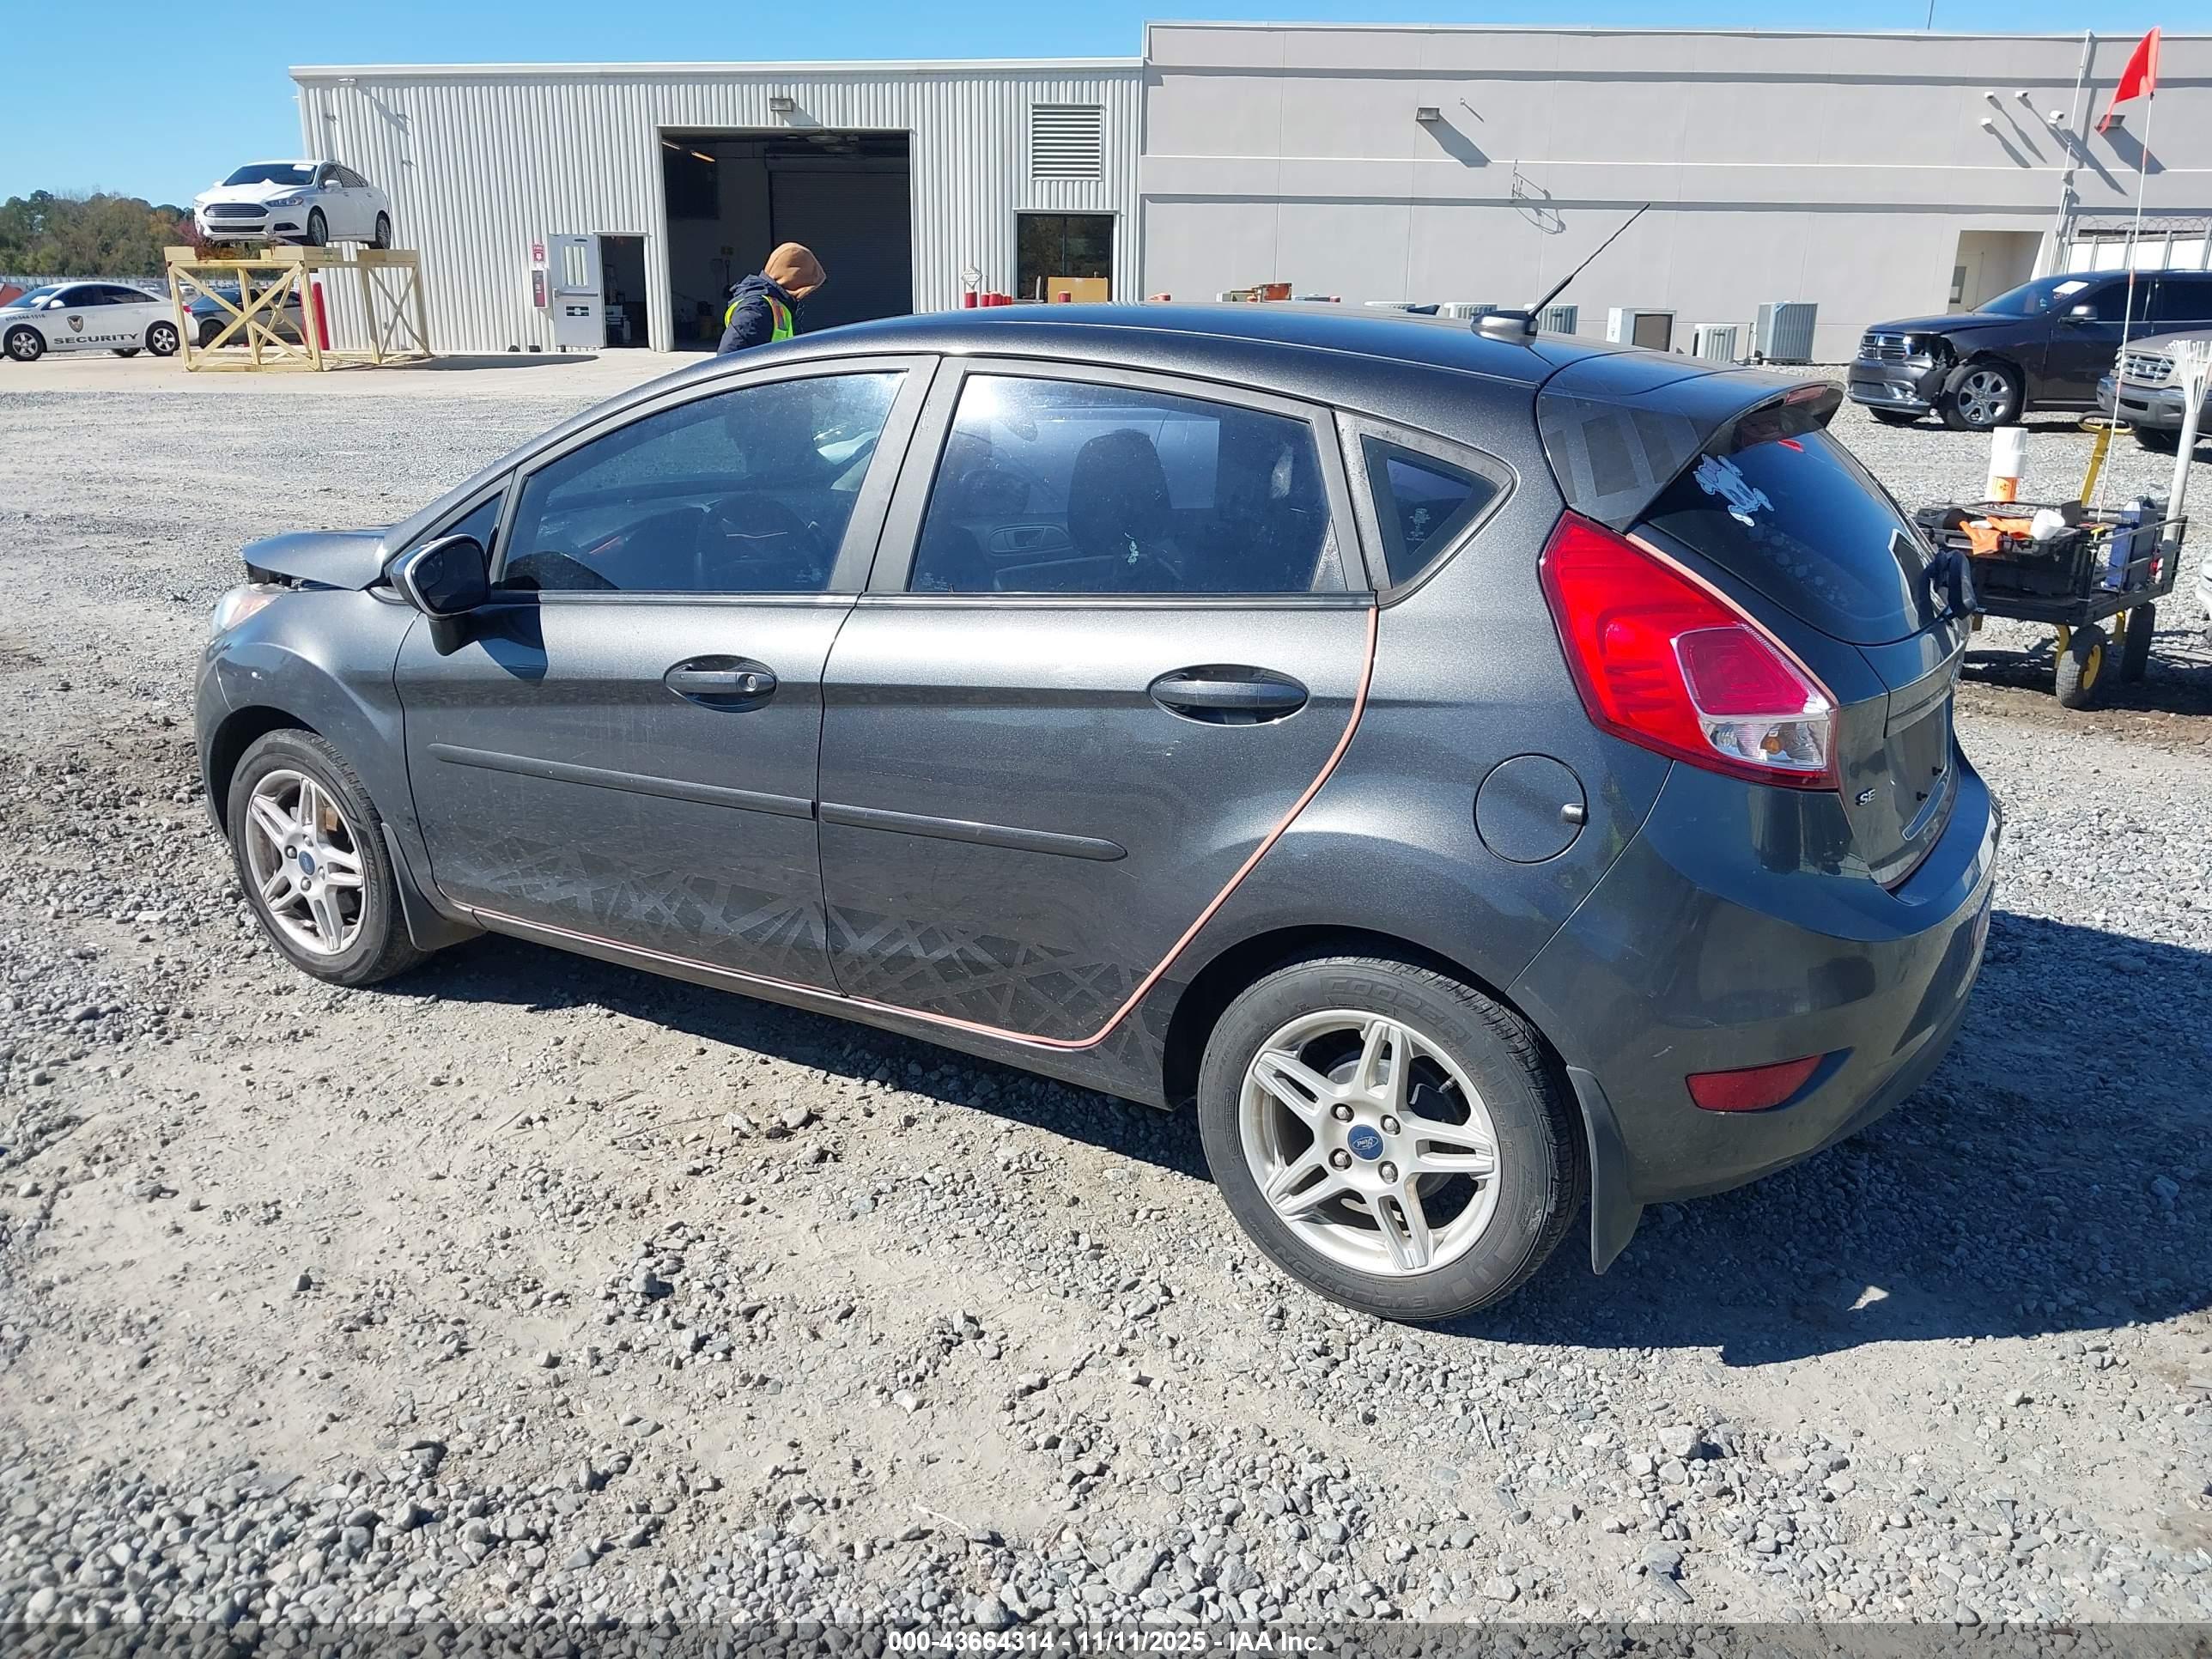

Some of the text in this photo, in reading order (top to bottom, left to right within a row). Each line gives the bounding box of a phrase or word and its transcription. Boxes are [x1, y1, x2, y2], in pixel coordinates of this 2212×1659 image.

[53, 333, 138, 344] SECURITY
[1859, 788, 1876, 805] SE
[1328, 977, 1471, 1045] COOPER
